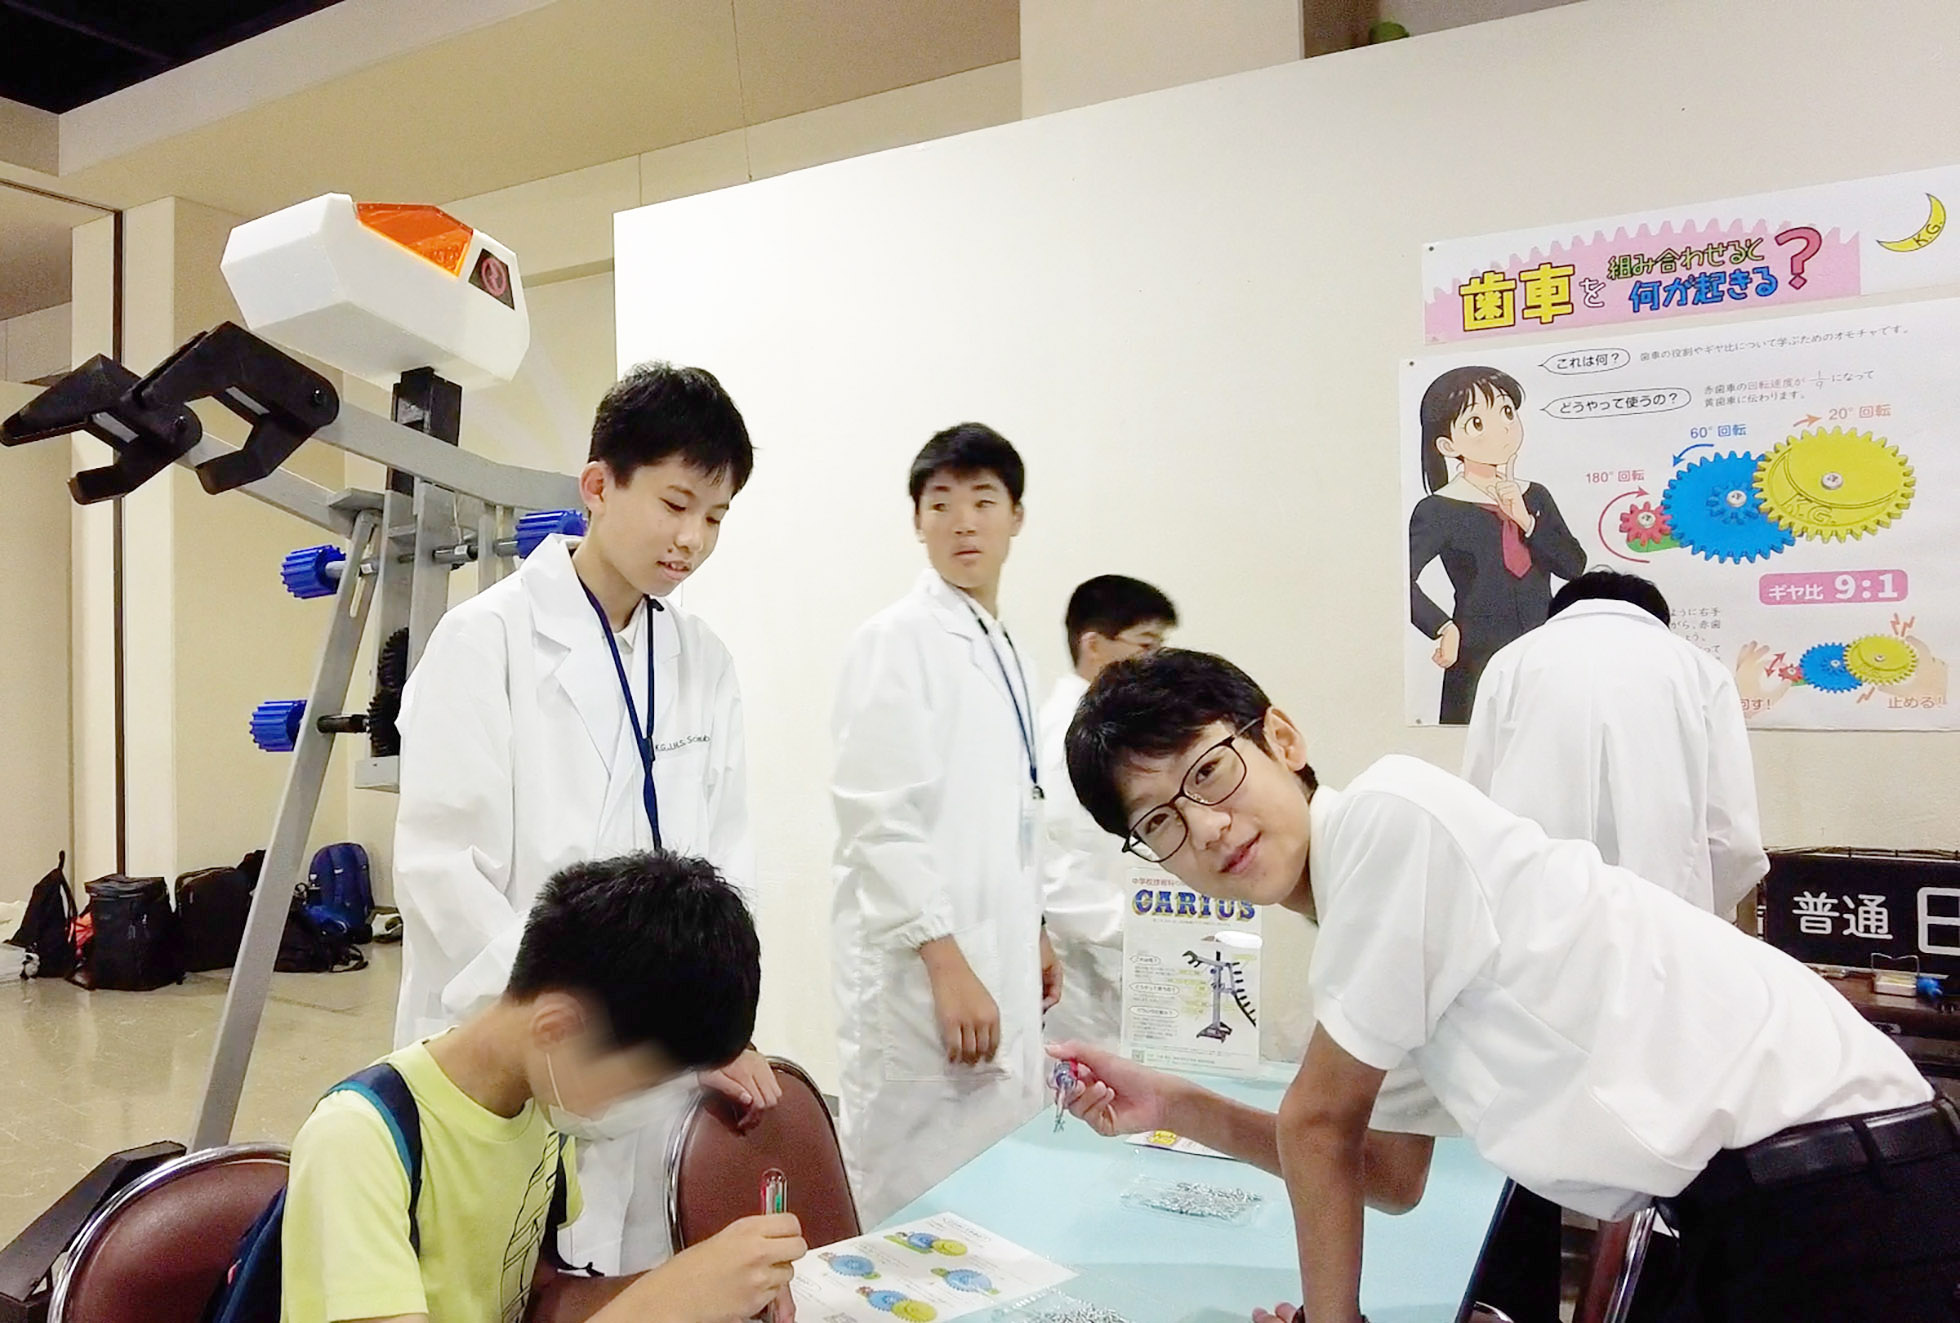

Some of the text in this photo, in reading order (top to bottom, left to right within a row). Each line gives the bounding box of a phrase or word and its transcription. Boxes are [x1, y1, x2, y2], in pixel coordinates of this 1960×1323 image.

[1606, 237, 1764, 280] 組み合わせると
[1458, 261, 1606, 332] 歯車を
[1628, 265, 1779, 313] 何が起きる
[1556, 352, 1620, 370] これは何？
[1559, 392, 1678, 414] どうやって使うの？
[1859, 404, 1891, 418] 回転
[1718, 424, 1747, 437] 回転
[1617, 469, 1645, 482] 回転
[1834, 573, 1898, 600] 9:1
[1132, 889, 1255, 920] CARIUS
[1792, 890, 1893, 940] 普通
